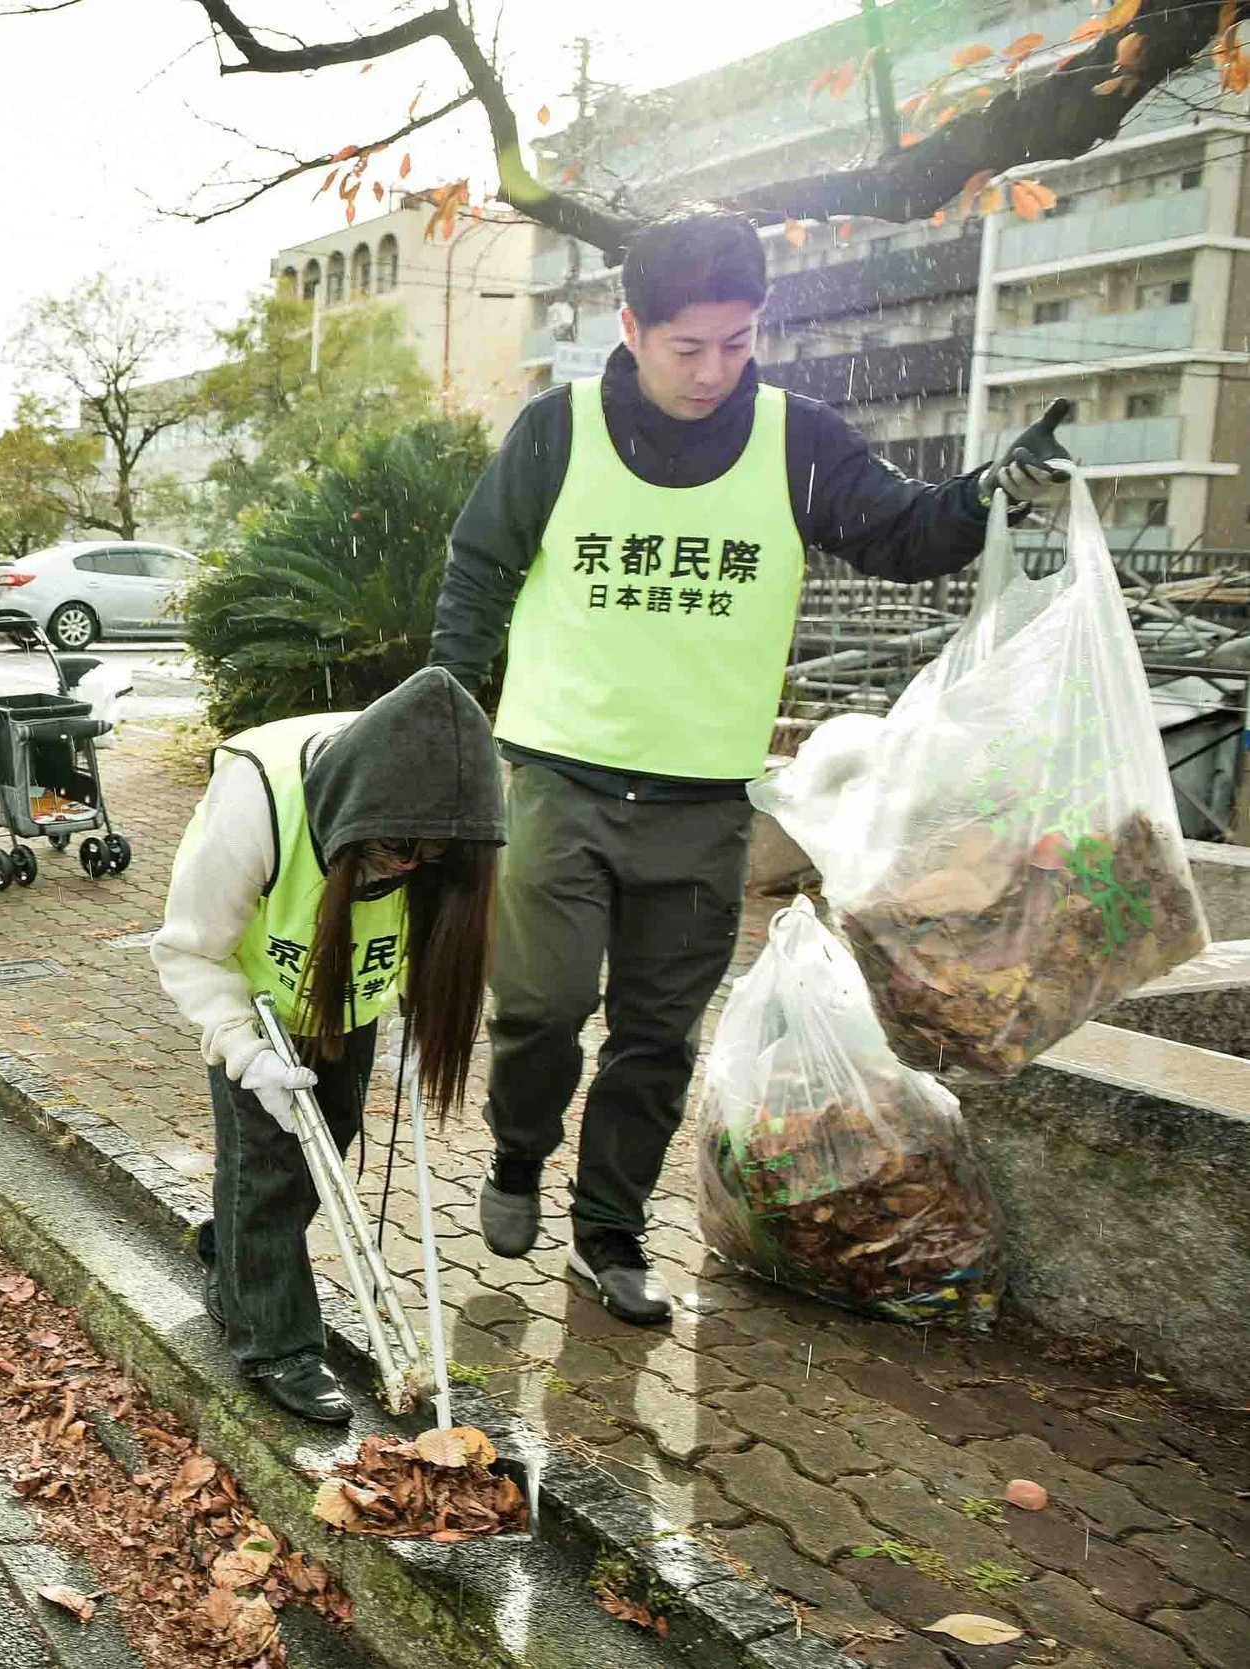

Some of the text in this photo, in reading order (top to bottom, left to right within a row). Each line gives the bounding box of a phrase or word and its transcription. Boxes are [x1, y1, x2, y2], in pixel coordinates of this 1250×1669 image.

[573, 532, 762, 584] 京都民際
[588, 584, 734, 617] 日本語学校
[265, 933, 399, 976] 京民
